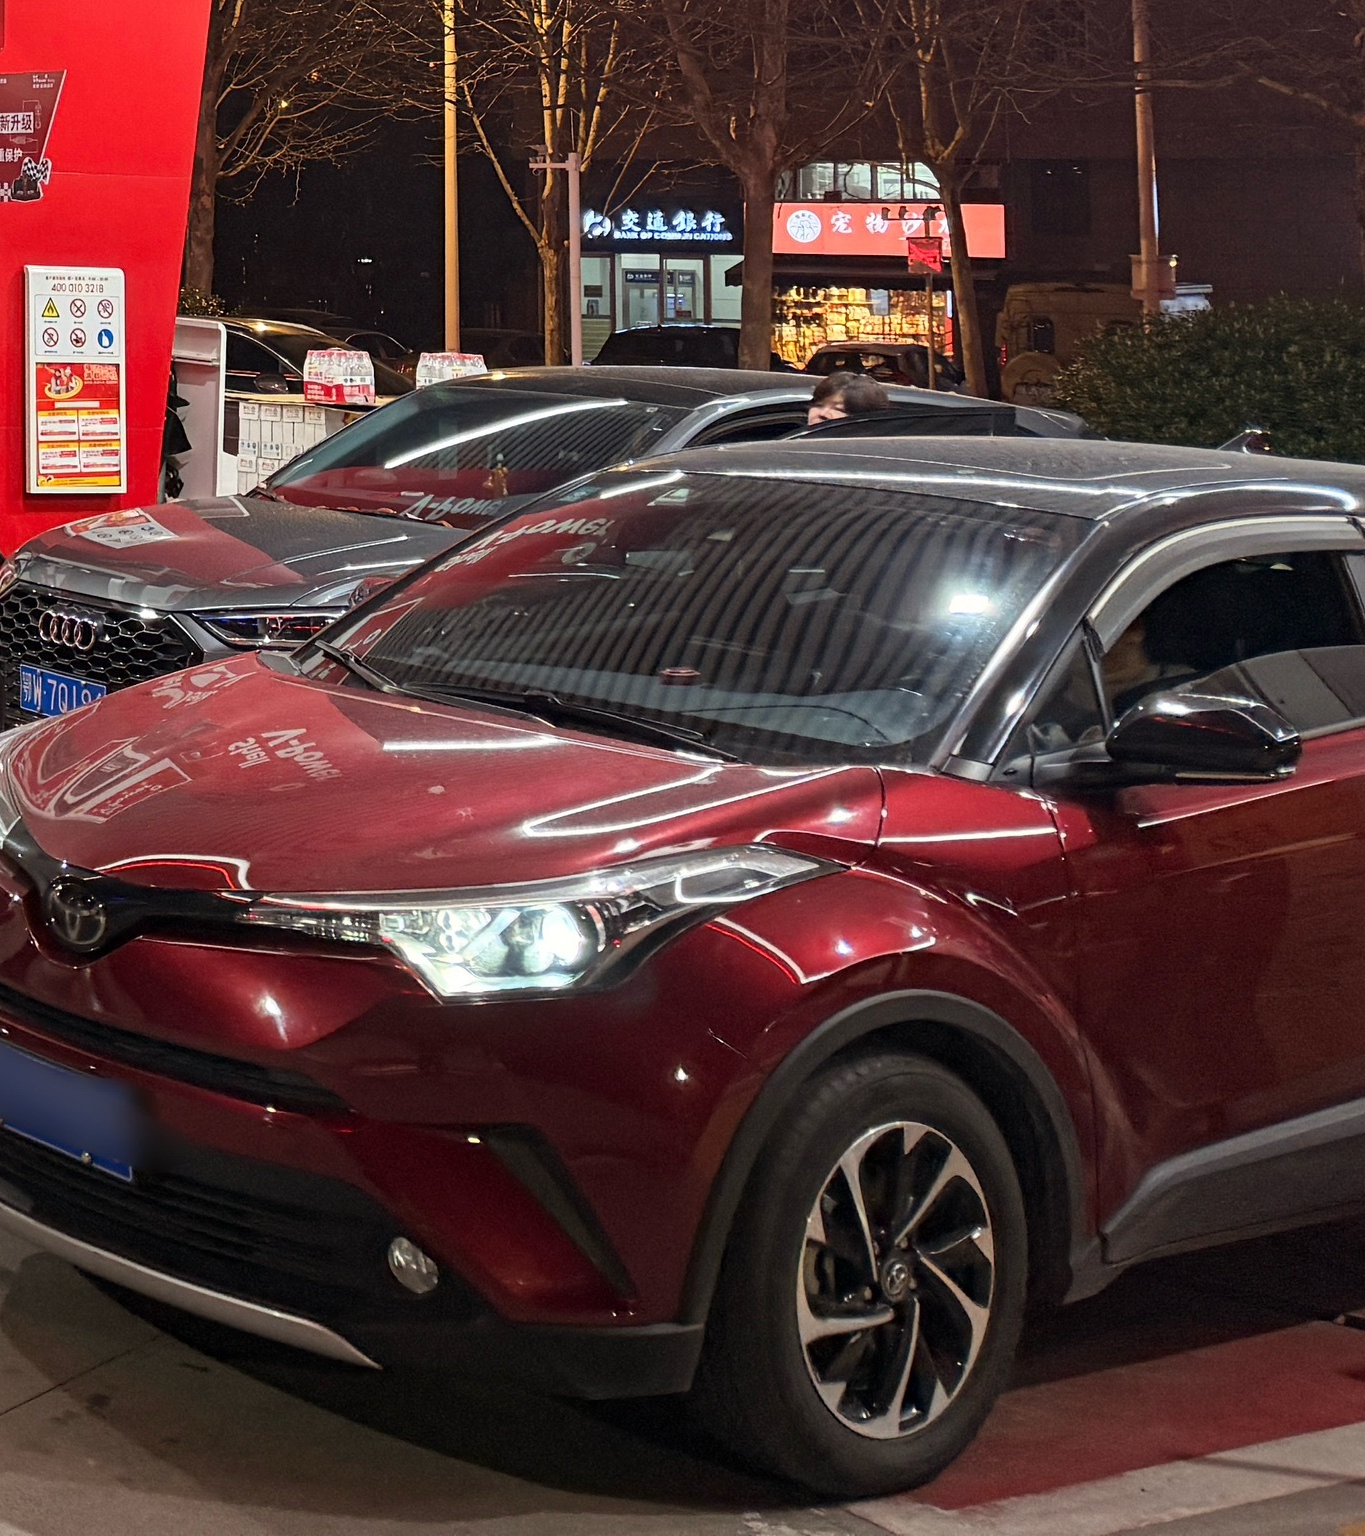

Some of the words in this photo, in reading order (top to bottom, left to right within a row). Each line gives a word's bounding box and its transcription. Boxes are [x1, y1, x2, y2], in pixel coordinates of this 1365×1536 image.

[621, 209, 726, 232] 交通银行
[51, 283, 67, 292] 400
[68, 283, 83, 293] 010
[85, 284, 104, 293] 3218
